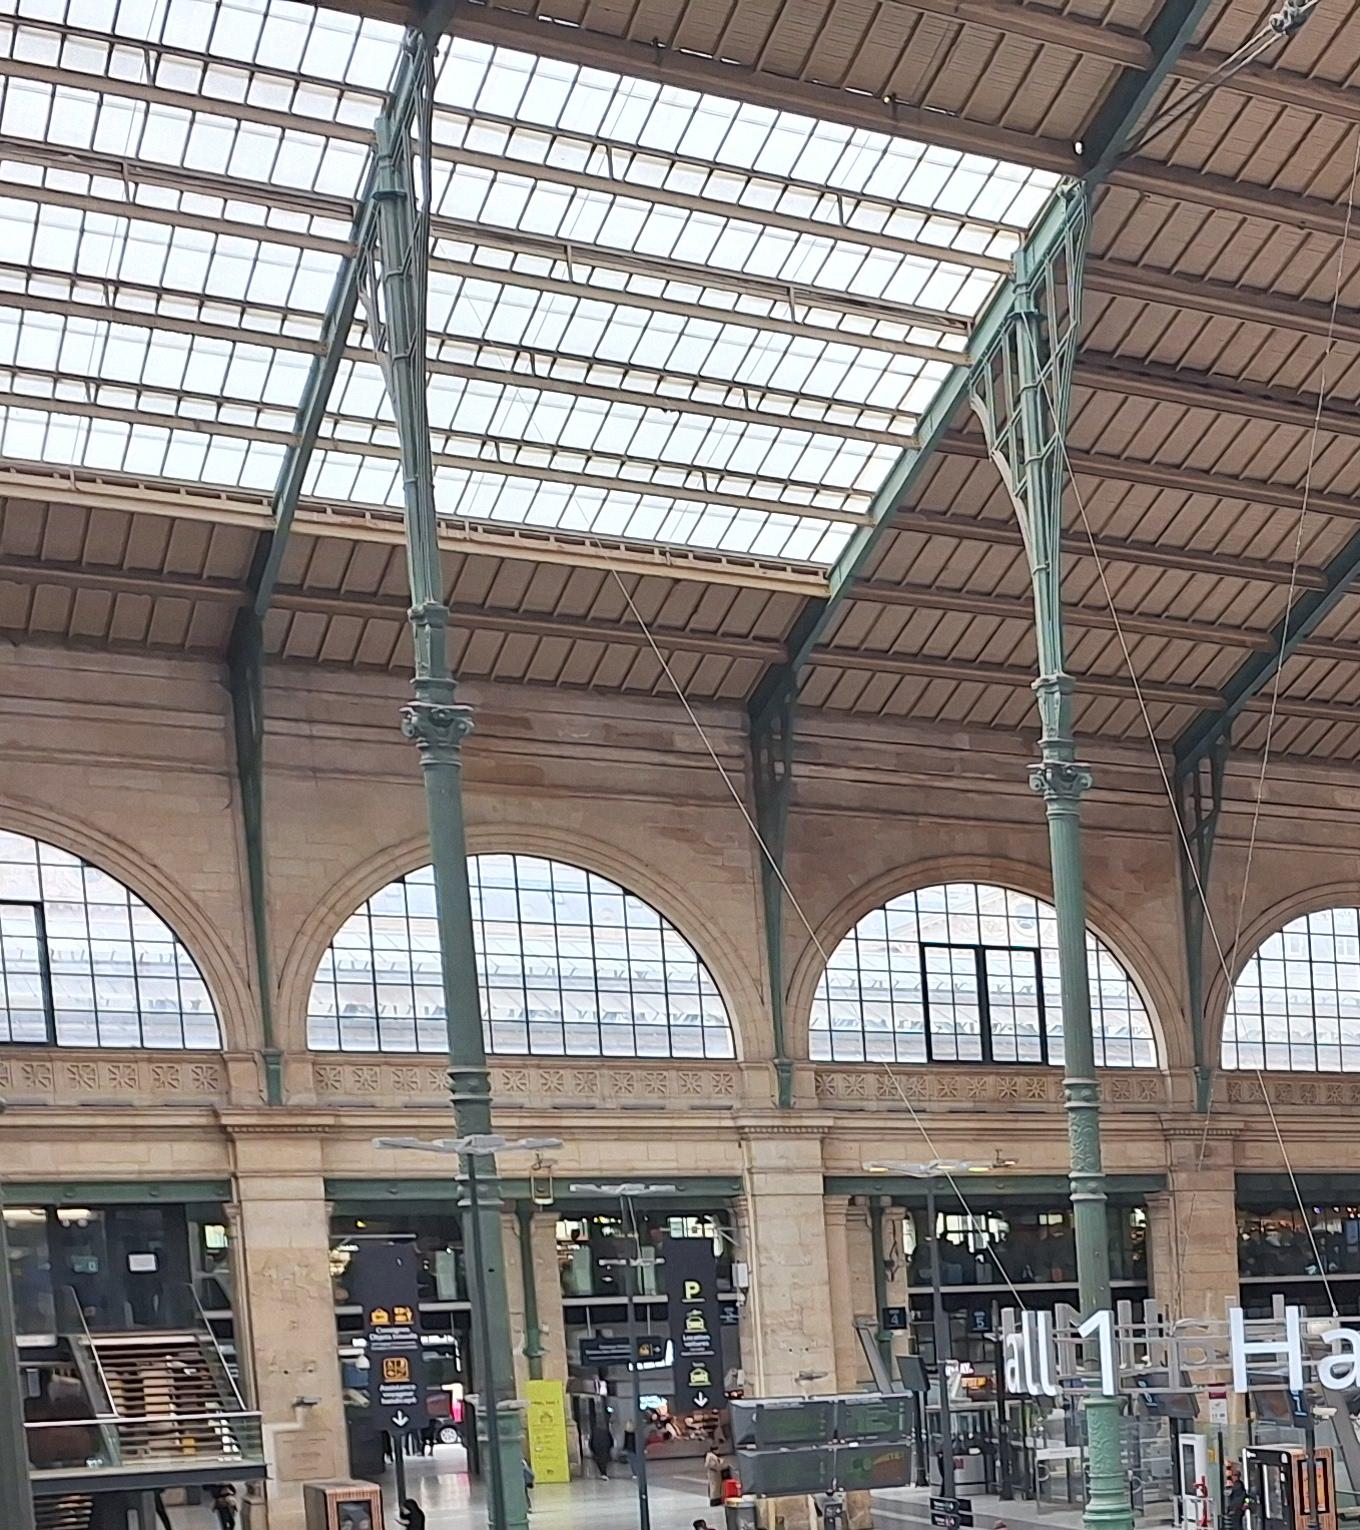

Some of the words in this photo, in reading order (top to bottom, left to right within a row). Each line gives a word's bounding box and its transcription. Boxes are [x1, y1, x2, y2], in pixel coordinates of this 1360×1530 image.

[684, 1280, 701, 1300] P
[890, 1314, 899, 1326] 4
[976, 1316, 985, 1328] 5
[1078, 1309, 1116, 1396] 1
